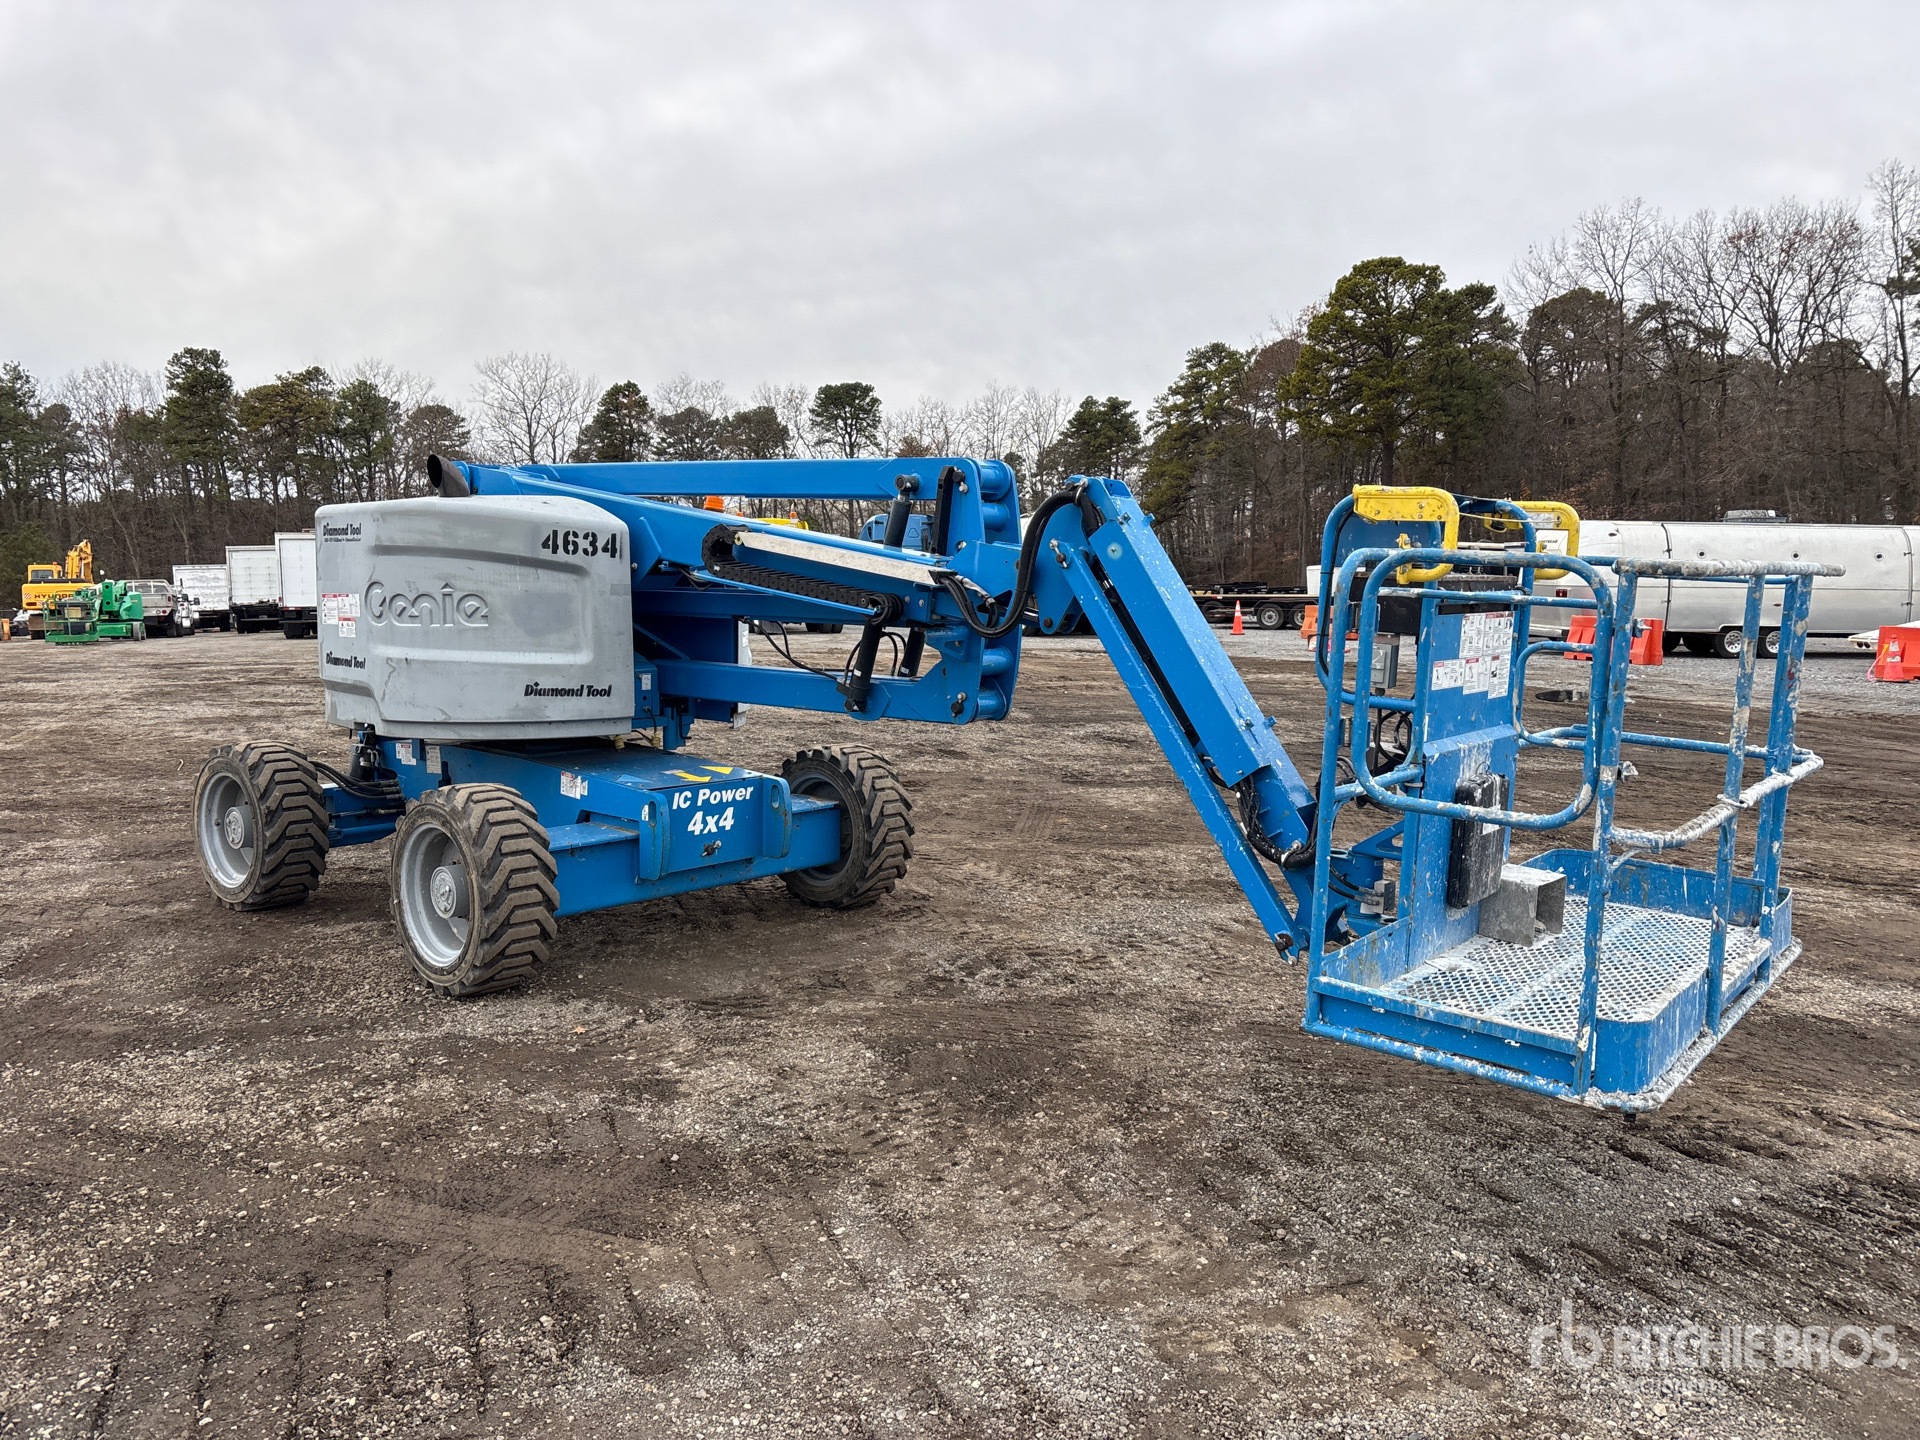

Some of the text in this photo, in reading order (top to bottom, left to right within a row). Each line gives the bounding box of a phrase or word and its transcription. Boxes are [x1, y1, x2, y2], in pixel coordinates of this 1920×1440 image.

[323, 522, 362, 536] Diamond Tool
[541, 529, 618, 559] 4634
[364, 580, 489, 627] Genie
[326, 651, 366, 669] Diamond Tool
[524, 681, 612, 697] Diamond Tool
[672, 786, 754, 810] IC Power
[687, 807, 735, 835] 4x4
